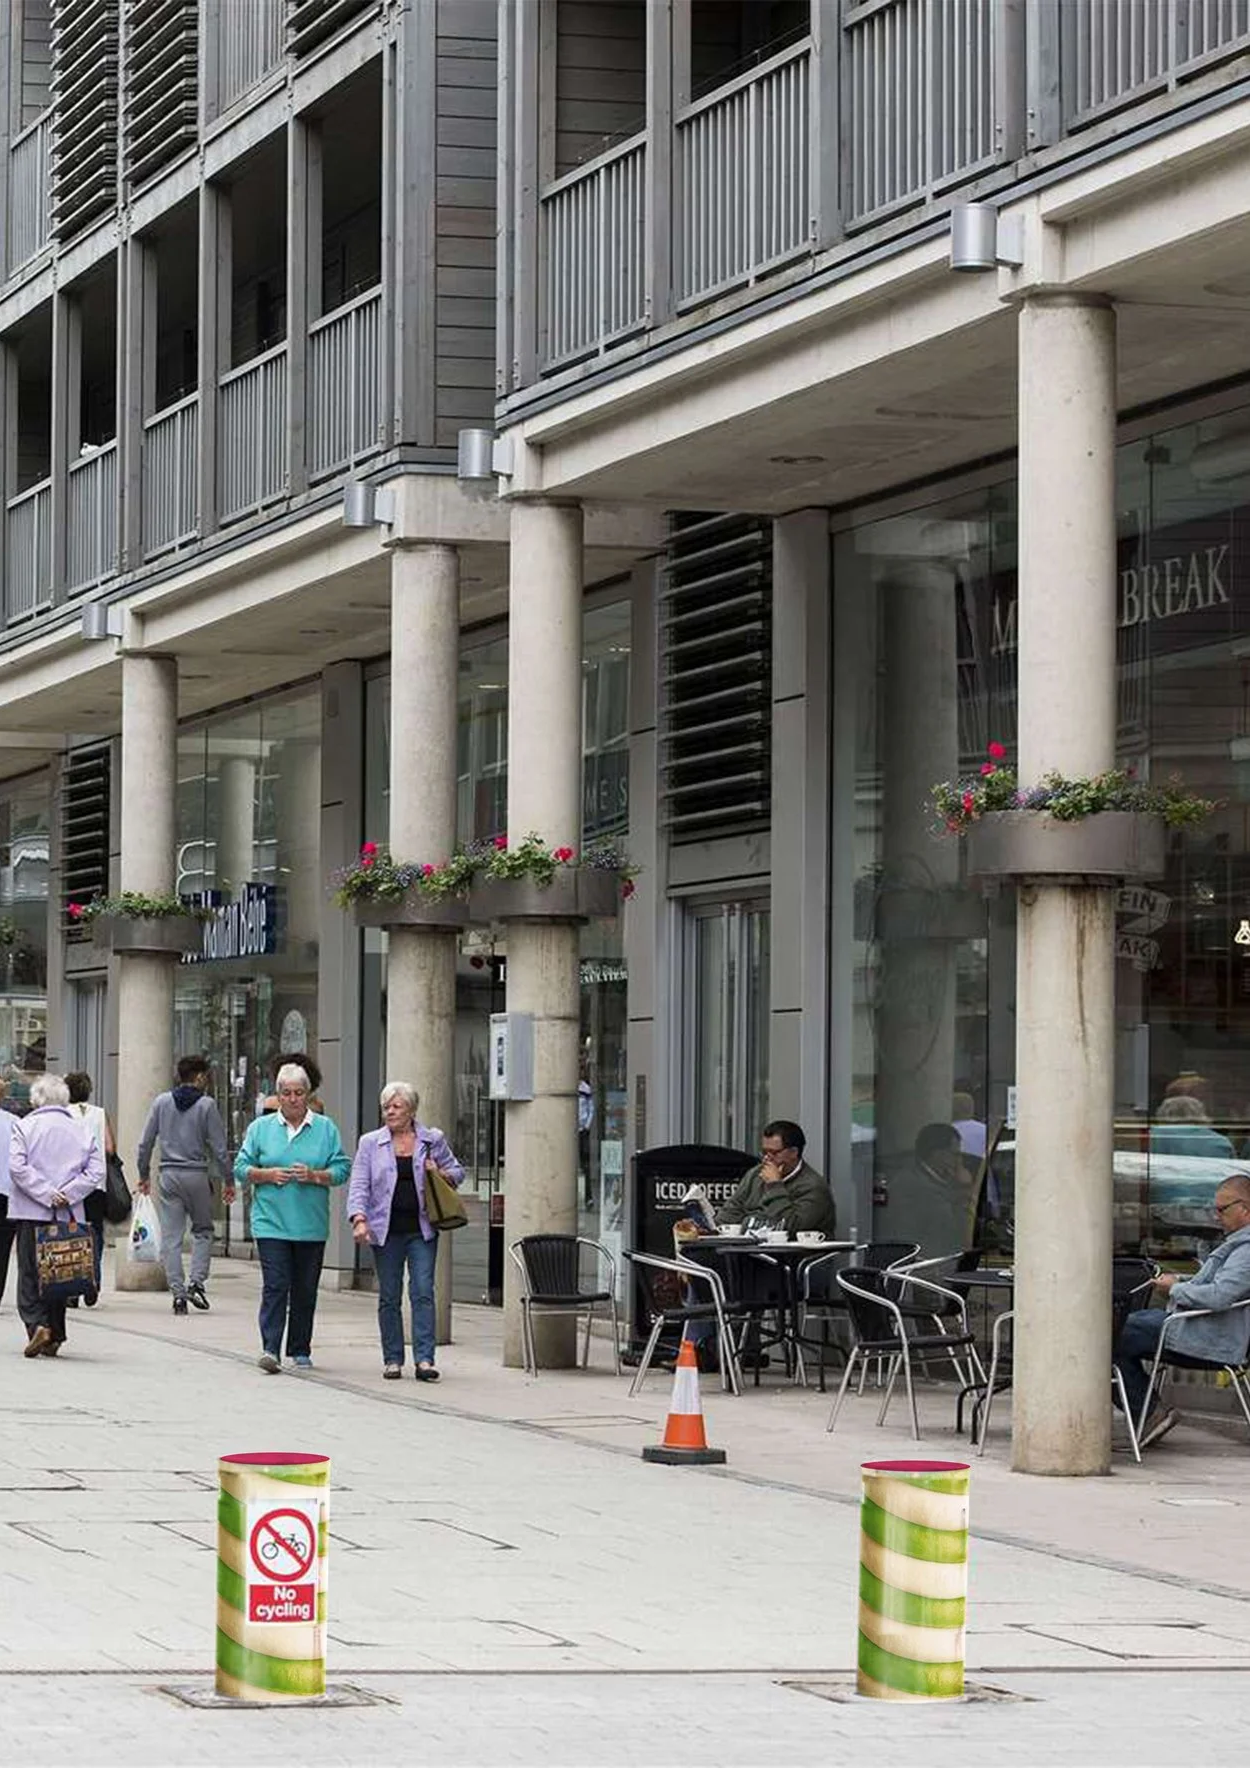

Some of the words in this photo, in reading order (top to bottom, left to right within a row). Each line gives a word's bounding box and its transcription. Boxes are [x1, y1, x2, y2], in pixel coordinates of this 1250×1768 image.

[1120, 544, 1229, 627] BREAK
[655, 1182, 687, 1200] ICED
[697, 1183, 739, 1200] OFFE
[273, 1586, 297, 1601] No
[256, 1602, 311, 1621] cycling
